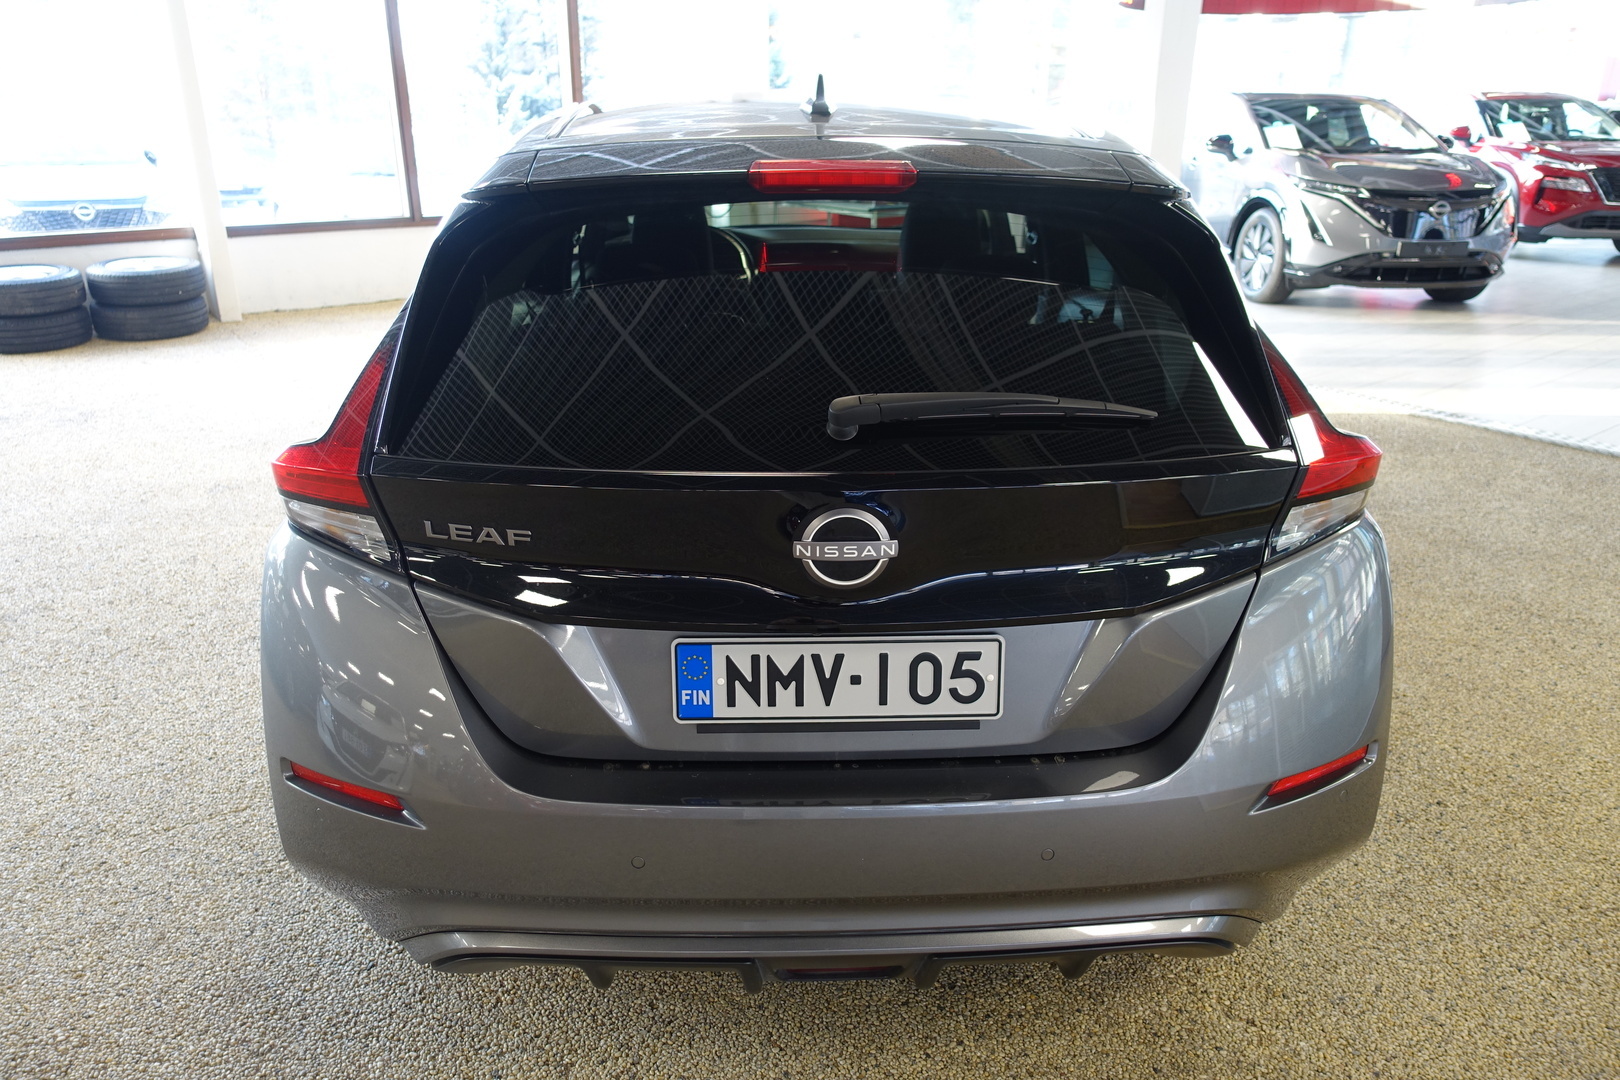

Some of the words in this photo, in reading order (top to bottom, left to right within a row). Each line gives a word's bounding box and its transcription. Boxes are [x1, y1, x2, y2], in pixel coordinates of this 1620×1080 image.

[423, 520, 532, 546] LEAF
[796, 543, 895, 558] NISSAN
[681, 689, 711, 706] FIN
